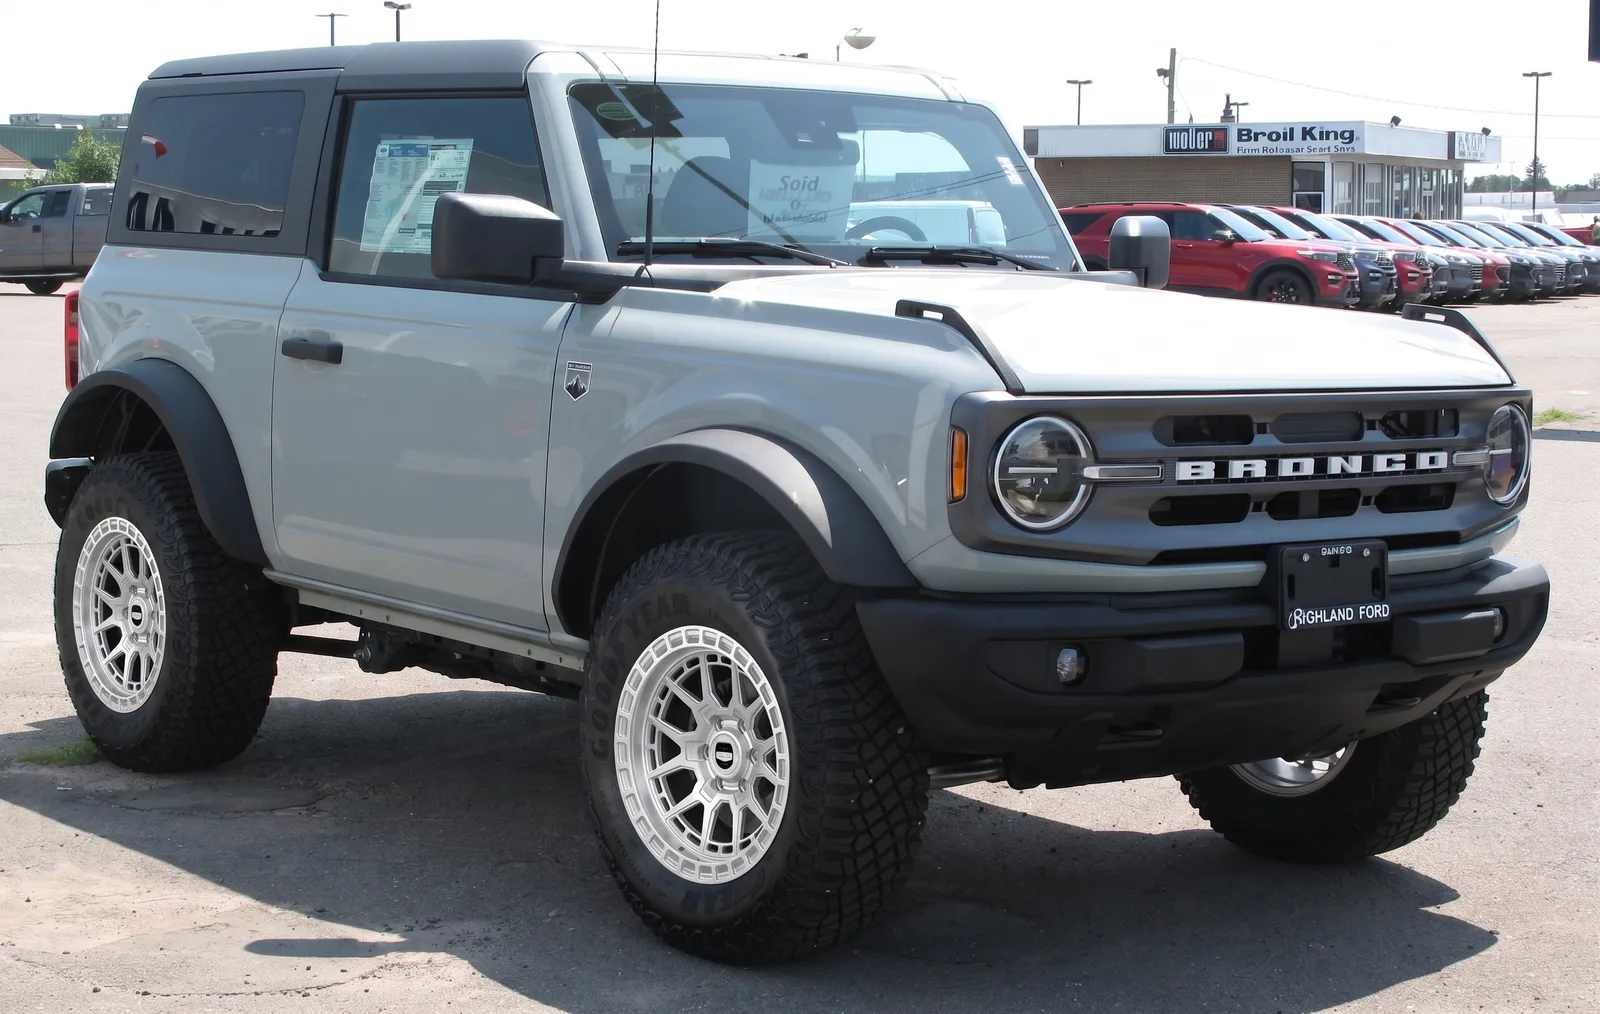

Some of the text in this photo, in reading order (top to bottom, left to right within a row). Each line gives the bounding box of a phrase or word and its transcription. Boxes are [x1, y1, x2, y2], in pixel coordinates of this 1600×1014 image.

[1237, 126, 1355, 145] Broil King
[1175, 451, 1448, 481] BRONCO
[1359, 604, 1390, 620] FORD
